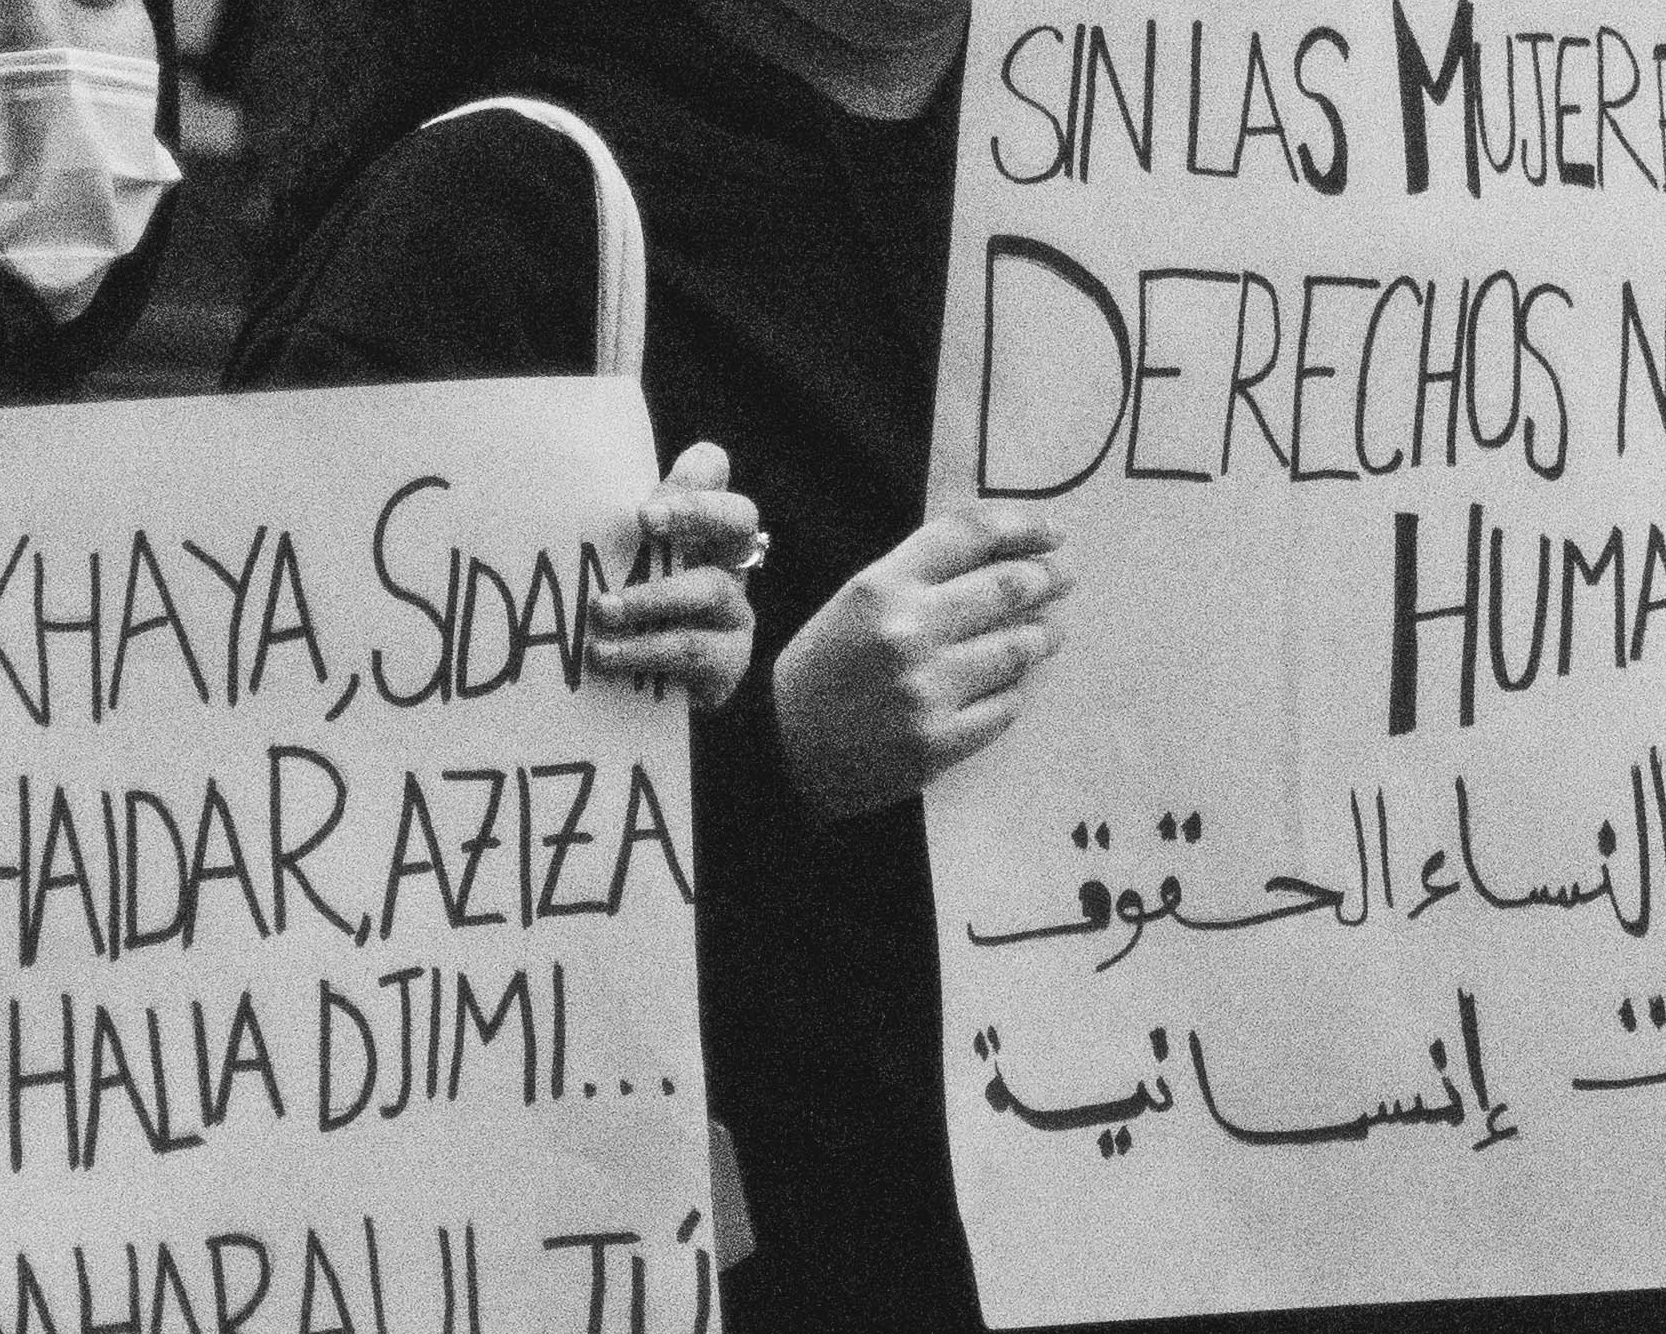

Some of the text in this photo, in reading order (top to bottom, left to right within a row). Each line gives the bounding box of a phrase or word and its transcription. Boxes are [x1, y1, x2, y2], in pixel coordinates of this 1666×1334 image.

[990, 19, 1156, 184] SIN
[1187, 19, 1349, 195] LAS
[977, 234, 1574, 500] DERECHOS
[378, 762, 693, 942] AZIZA
[967, 785, 1394, 974] الحقوق
[972, 987, 1519, 1159] إنسانية
